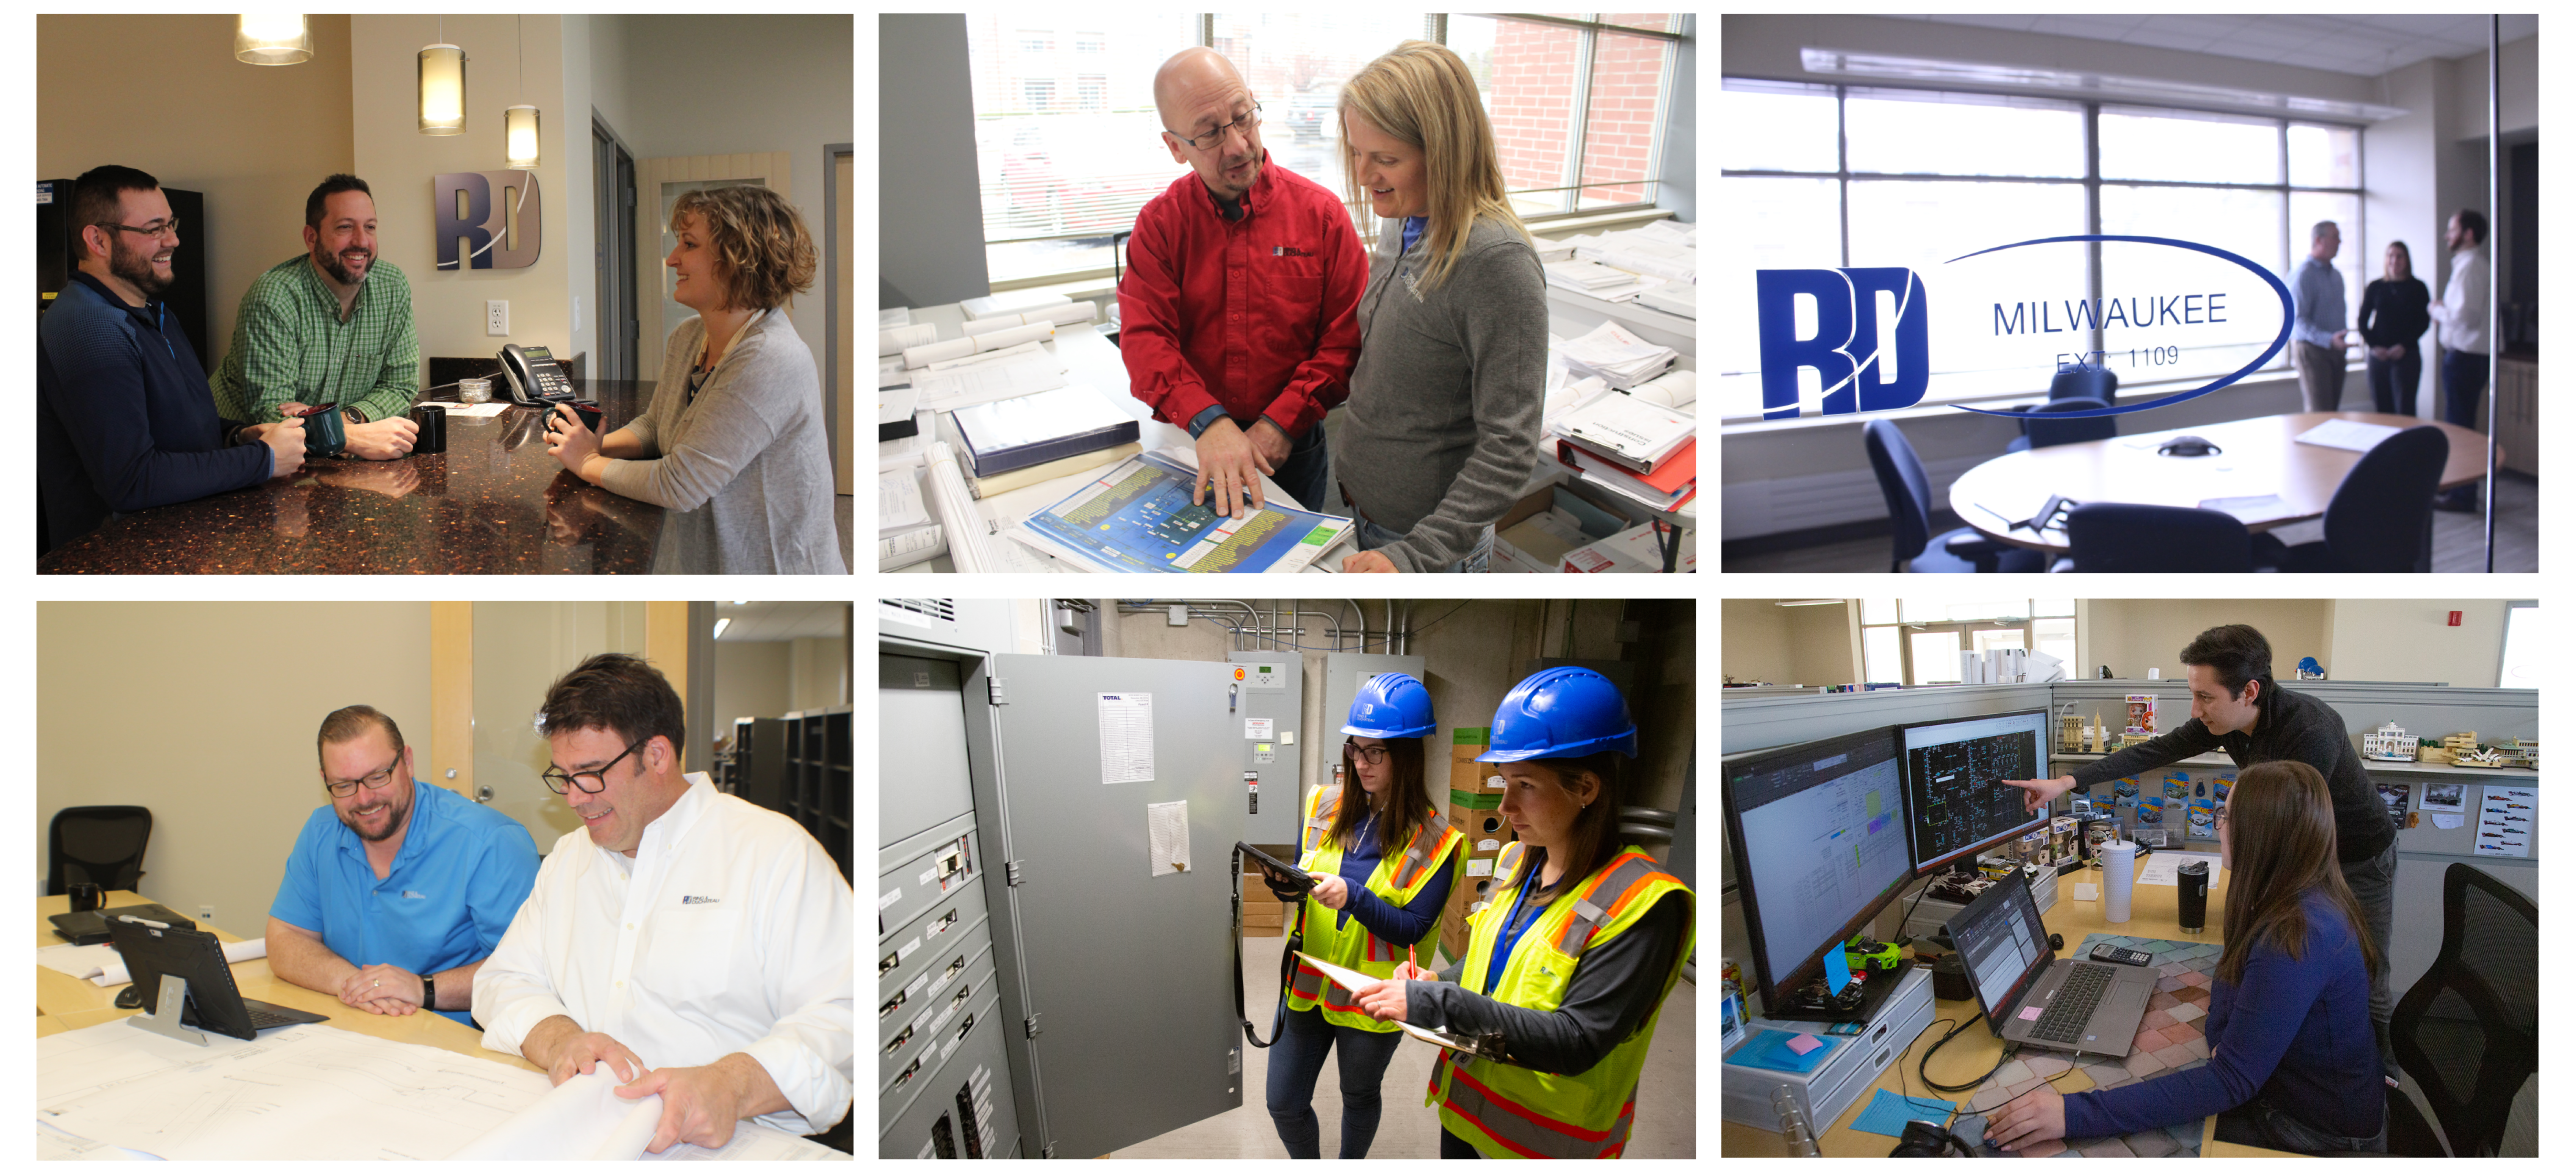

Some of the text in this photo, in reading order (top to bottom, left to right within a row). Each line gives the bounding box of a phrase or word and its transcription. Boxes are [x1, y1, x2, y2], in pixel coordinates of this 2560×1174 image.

[434, 170, 541, 271] RD
[1756, 266, 1930, 421] RD
[1993, 293, 2228, 336] MILWAUKEE
[2056, 345, 2179, 375] EXT: 1109
